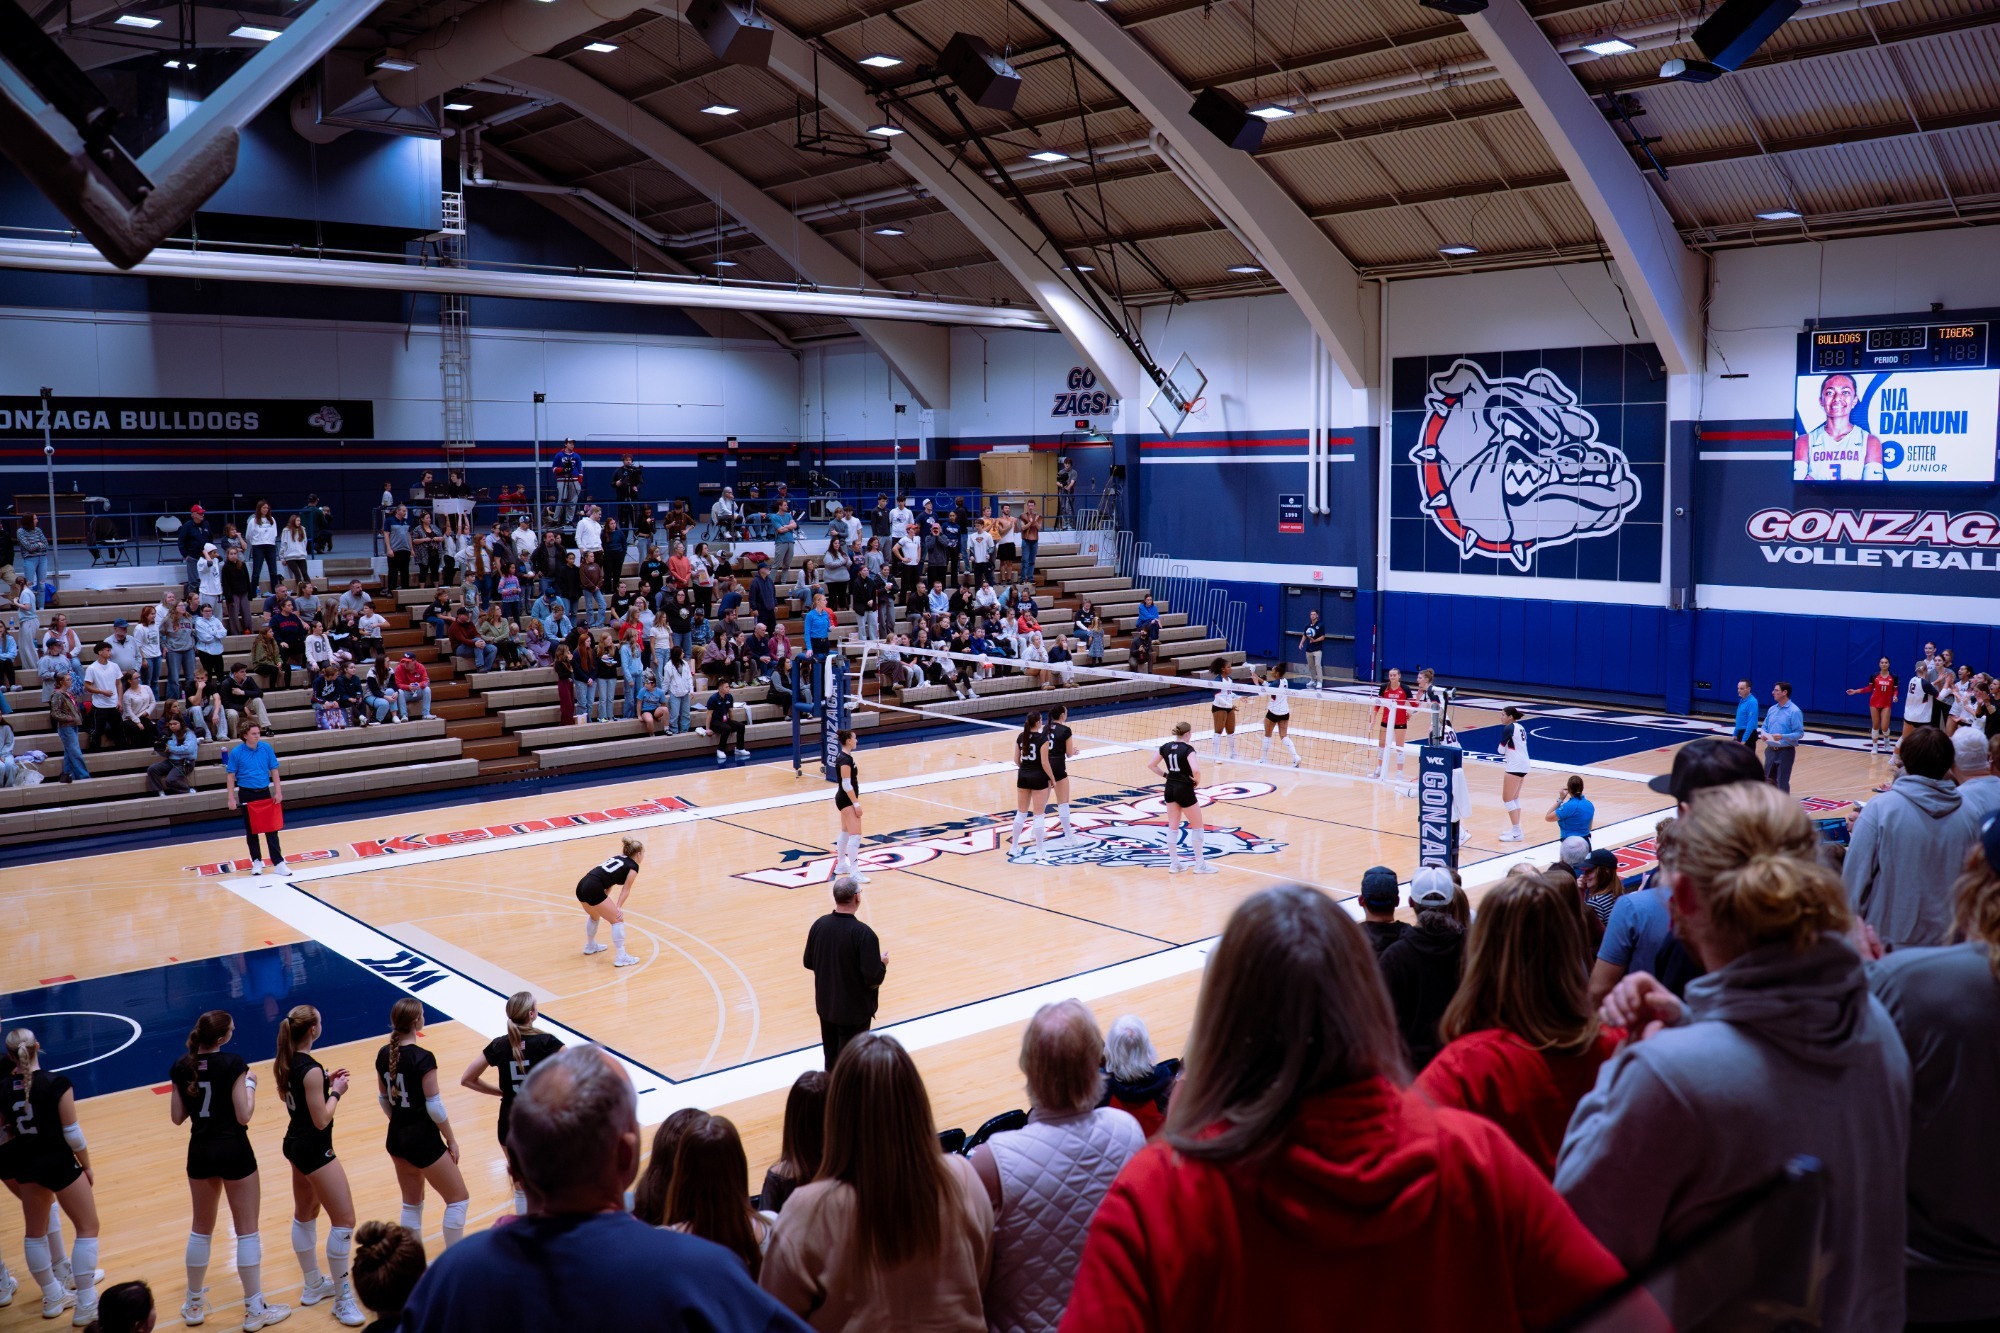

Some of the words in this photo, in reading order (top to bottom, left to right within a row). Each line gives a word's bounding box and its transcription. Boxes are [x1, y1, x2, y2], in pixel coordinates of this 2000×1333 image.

[1818, 333, 1861, 345] BULLDOGS
[1939, 327, 1974, 338] TIGERS
[1874, 356, 1898, 364] PERIOD
[1067, 367, 1097, 391] GO
[1051, 391, 1112, 417] ZAGS!
[1880, 388, 1909, 411] NIA
[120, 410, 259, 430] BULLDOGS
[1880, 410, 1968, 435] DAMUNI
[1813, 450, 1859, 462] GONZAGA
[1883, 448, 1896, 462] 3
[1907, 446, 1936, 462] SETTER
[1829, 464, 1842, 480] 3
[1907, 464, 1948, 473] JUNIOR
[1745, 506, 2000, 549] GONZAG
[1168, 753, 1181, 772] 11
[349, 796, 700, 858] Kennel
[199, 1082, 212, 1118] 7
[12, 1100, 38, 1135] 2
